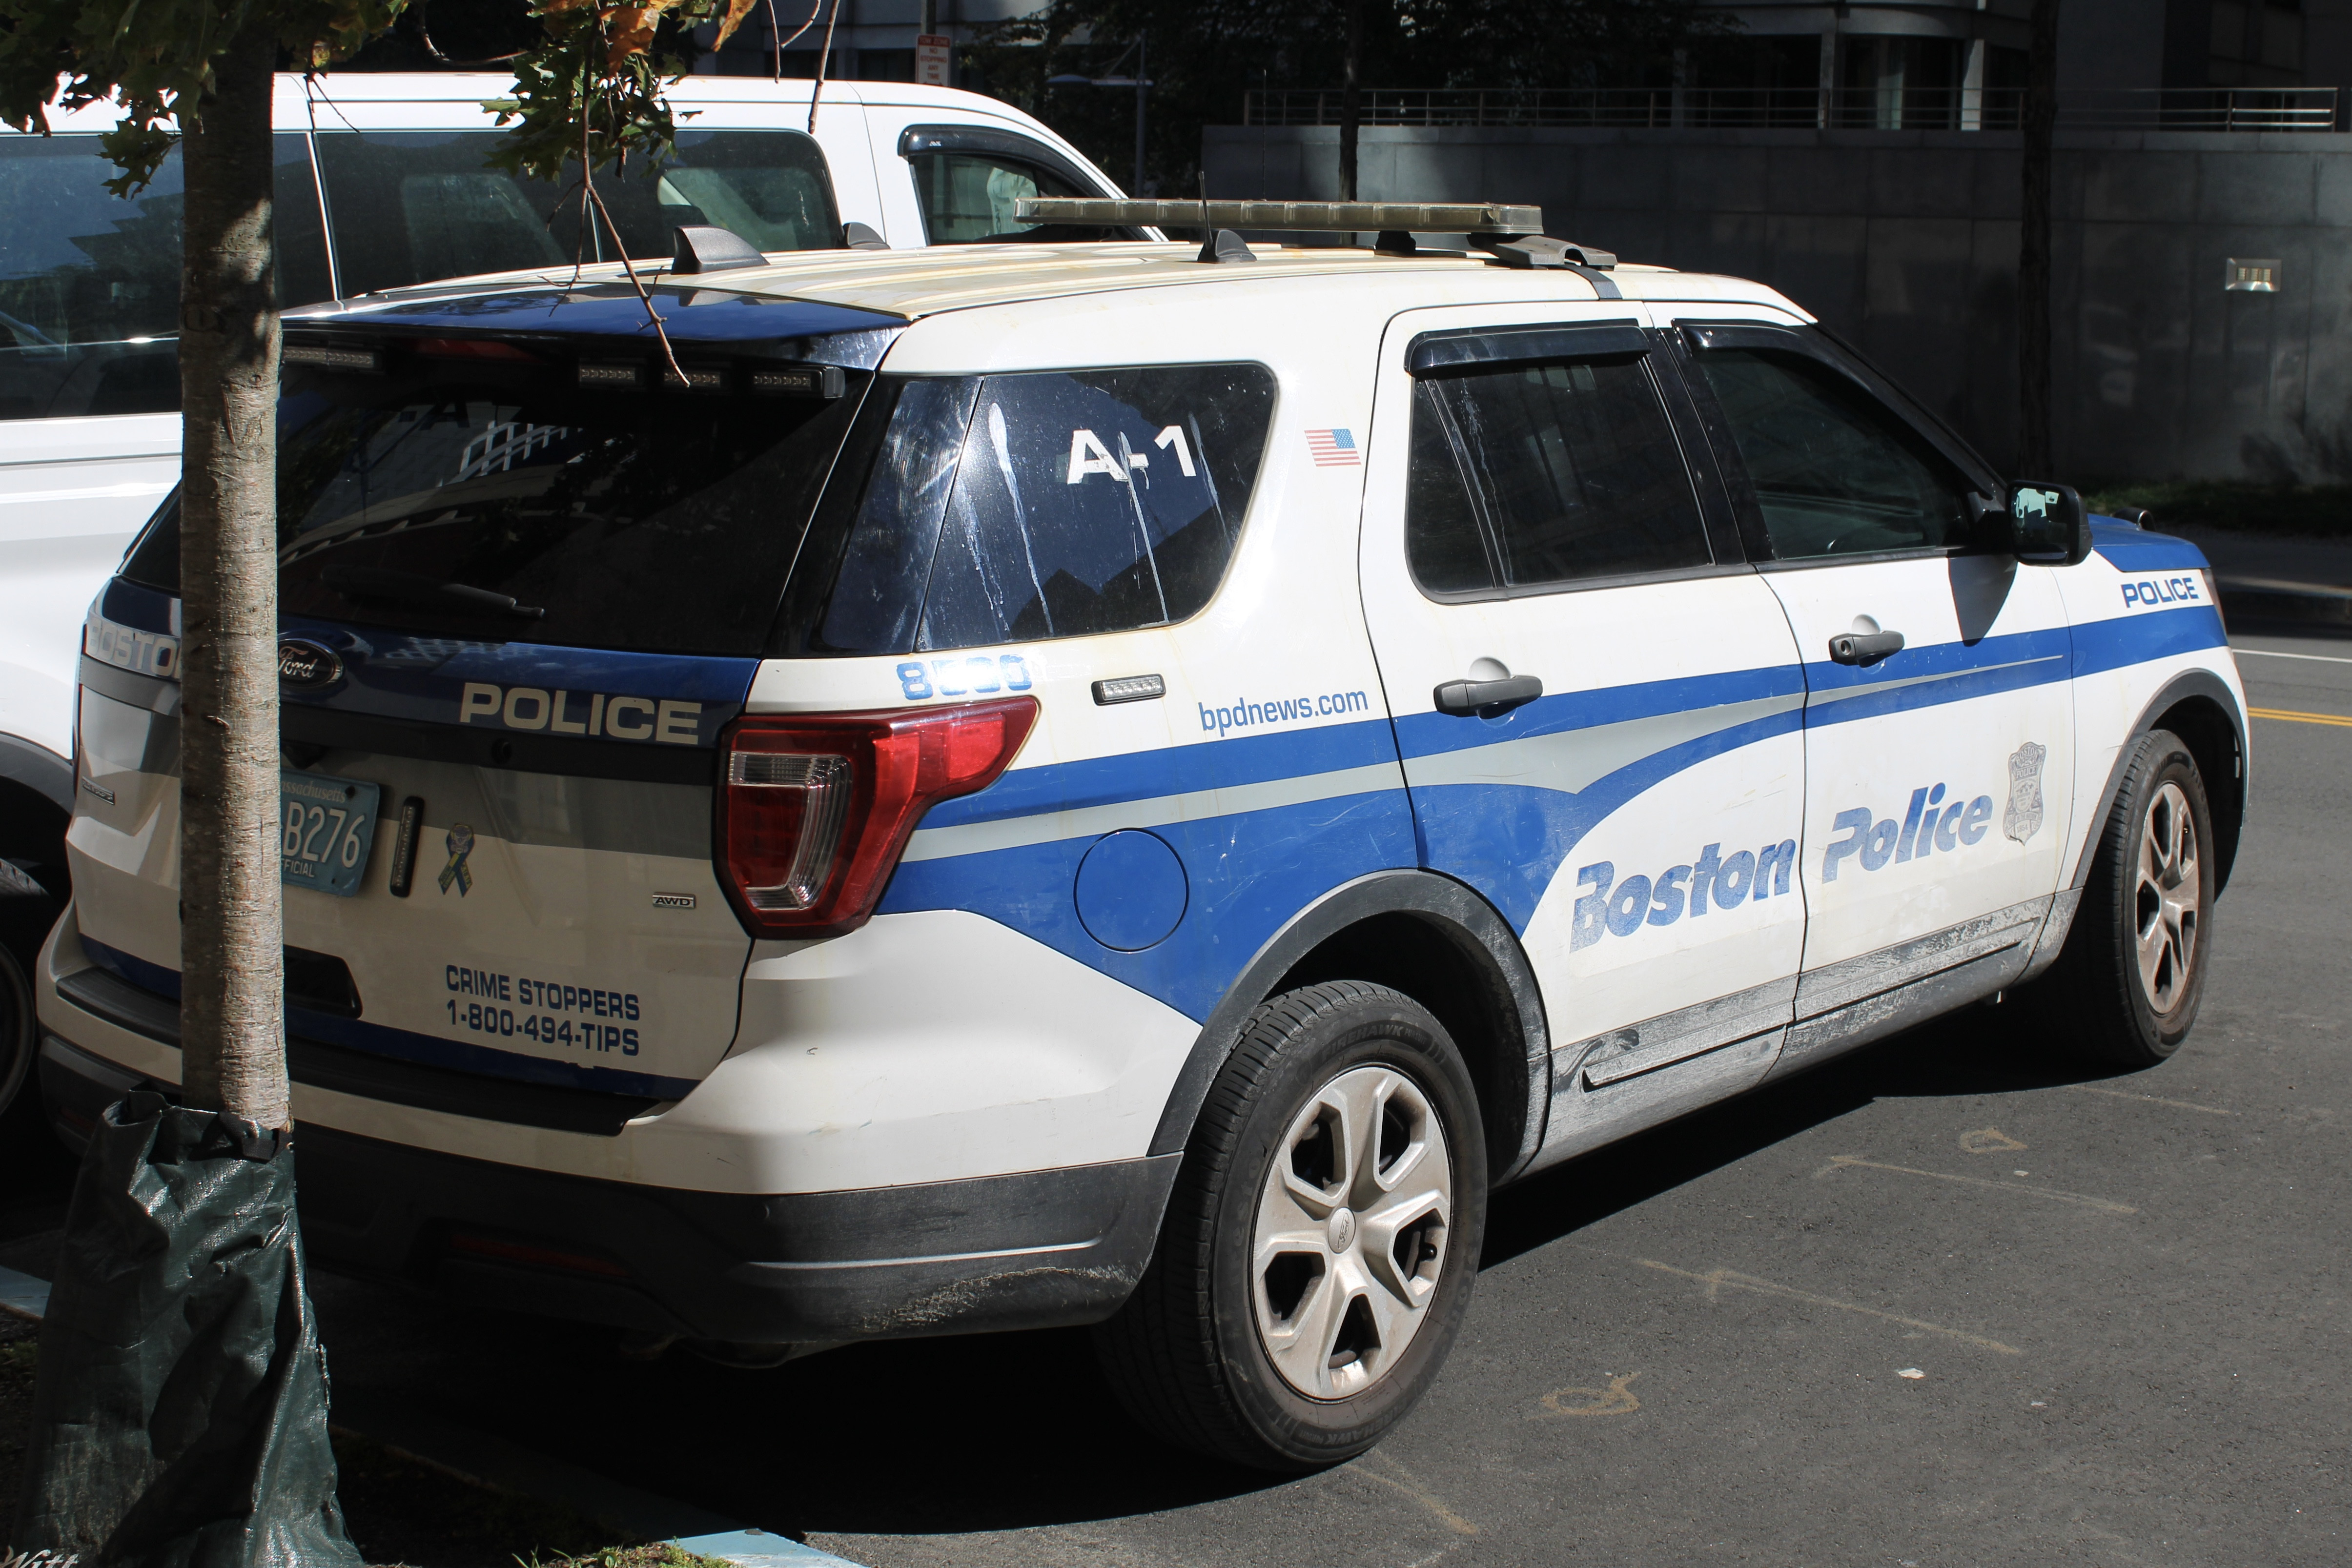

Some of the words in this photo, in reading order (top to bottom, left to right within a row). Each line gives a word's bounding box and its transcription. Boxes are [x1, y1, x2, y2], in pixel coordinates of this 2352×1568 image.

[1066, 425, 1197, 485] A-1
[2121, 577, 2199, 609] POLICE
[459, 681, 703, 745] POLICE
[1198, 690, 1369, 736] bpdnews.com
[281, 780, 346, 803] assachusetts
[2016, 765, 2036, 779] POLICE
[282, 858, 315, 877] FICIAL
[1569, 838, 1796, 953] Boston
[1822, 782, 1993, 884] Police
[655, 897, 691, 906] AWD
[446, 964, 511, 1002] CRIME
[518, 977, 641, 1021] STOPPERS
[446, 999, 640, 1057] 1-800-494-TIPS
[1322, 1024, 1404, 1062] FIREHAWK
